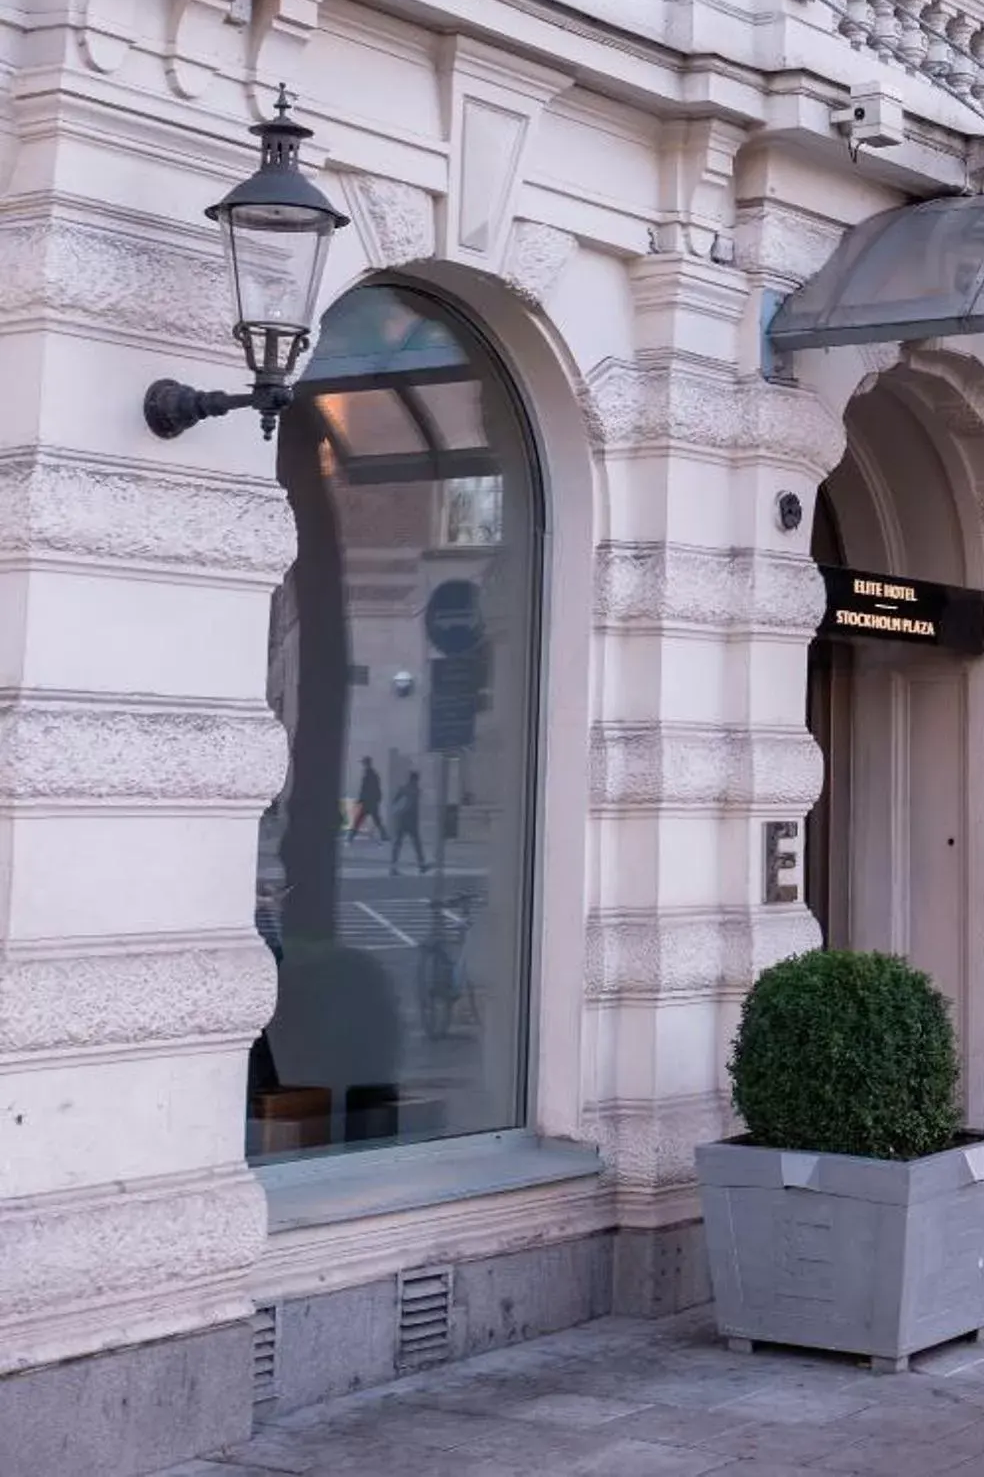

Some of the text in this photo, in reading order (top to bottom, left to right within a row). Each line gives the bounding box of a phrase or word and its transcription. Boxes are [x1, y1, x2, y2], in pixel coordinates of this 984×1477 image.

[853, 578, 918, 602] ELITE HOTEL
[836, 609, 935, 636] STOCKHOLM PLAZA
[763, 821, 798, 903] E
